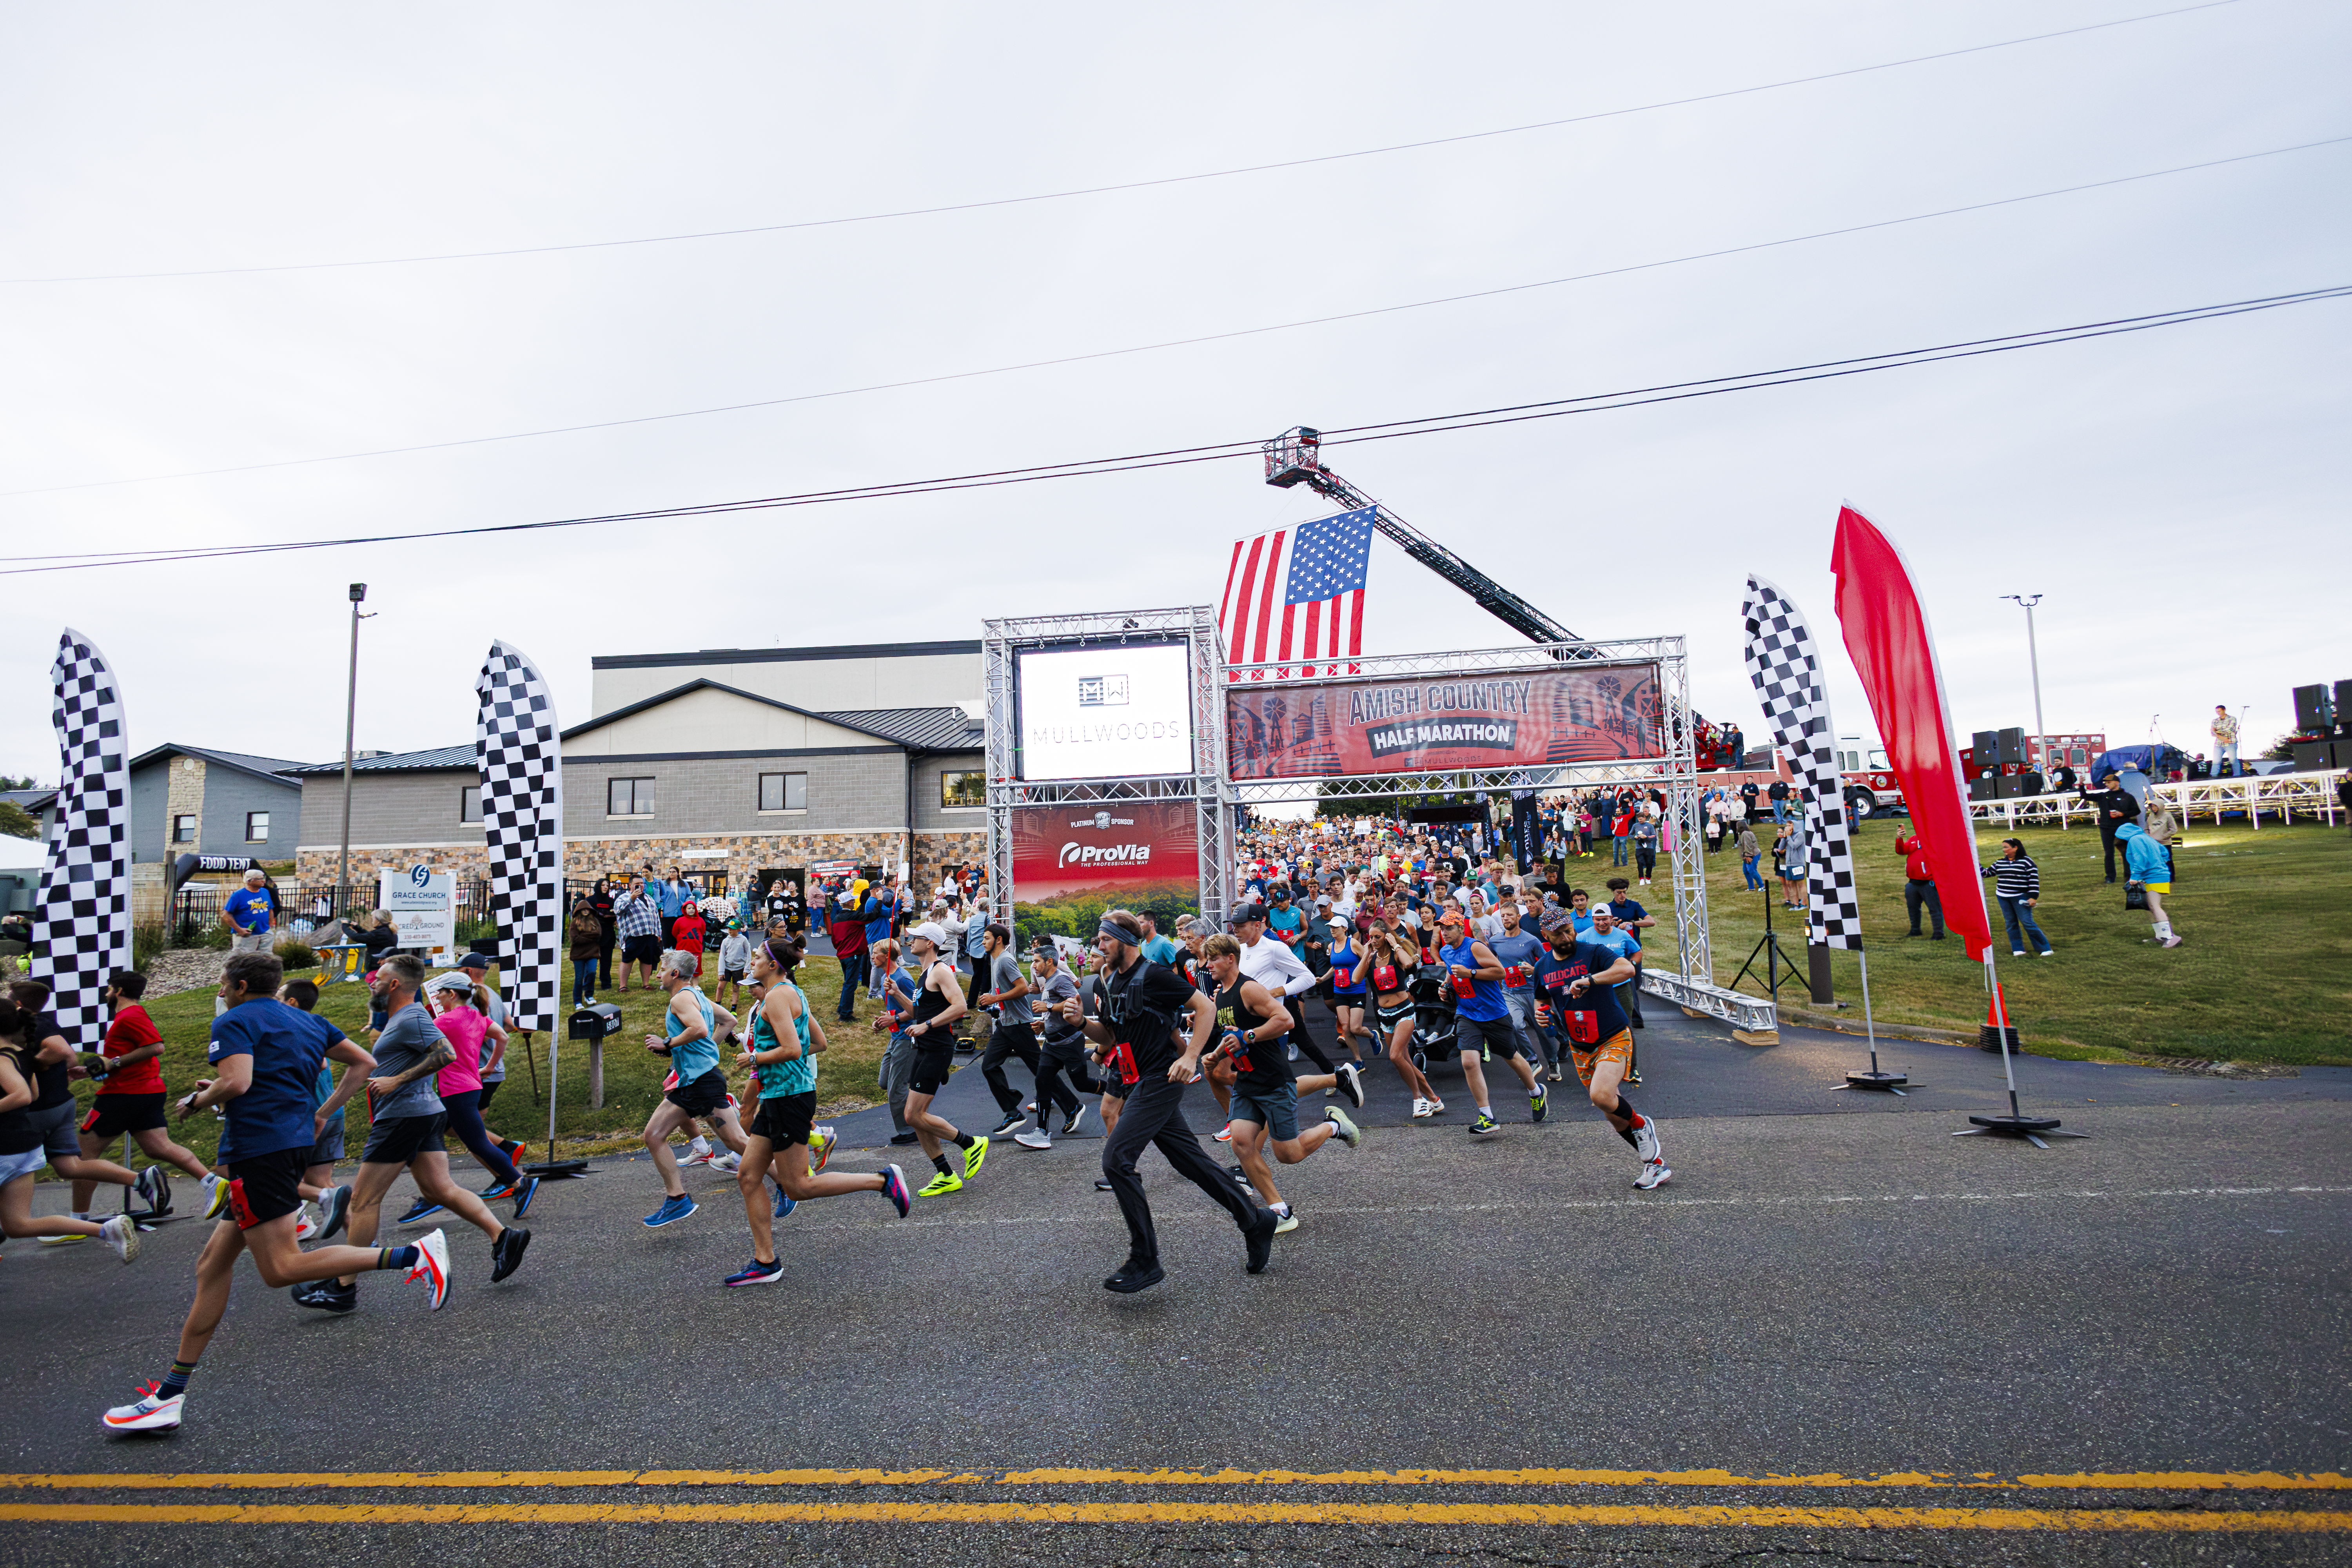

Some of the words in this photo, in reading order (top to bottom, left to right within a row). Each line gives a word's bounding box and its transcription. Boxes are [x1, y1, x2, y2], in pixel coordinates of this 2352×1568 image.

[1349, 686, 1421, 726] AMISH
[1426, 680, 1532, 715] COUNTRY
[1034, 721, 1179, 744] MULLWOODS
[1374, 728, 1414, 750] HALF
[1417, 724, 1510, 743] MARATHON
[1071, 819, 1094, 828] PLATINUM
[200, 857, 226, 869] FOOD
[227, 857, 251, 870] TENT
[1507, 975, 1521, 985] 237
[1543, 964, 1588, 984] WILDCATS
[1378, 976, 1393, 987] 285
[1575, 1026, 1588, 1038] 91
